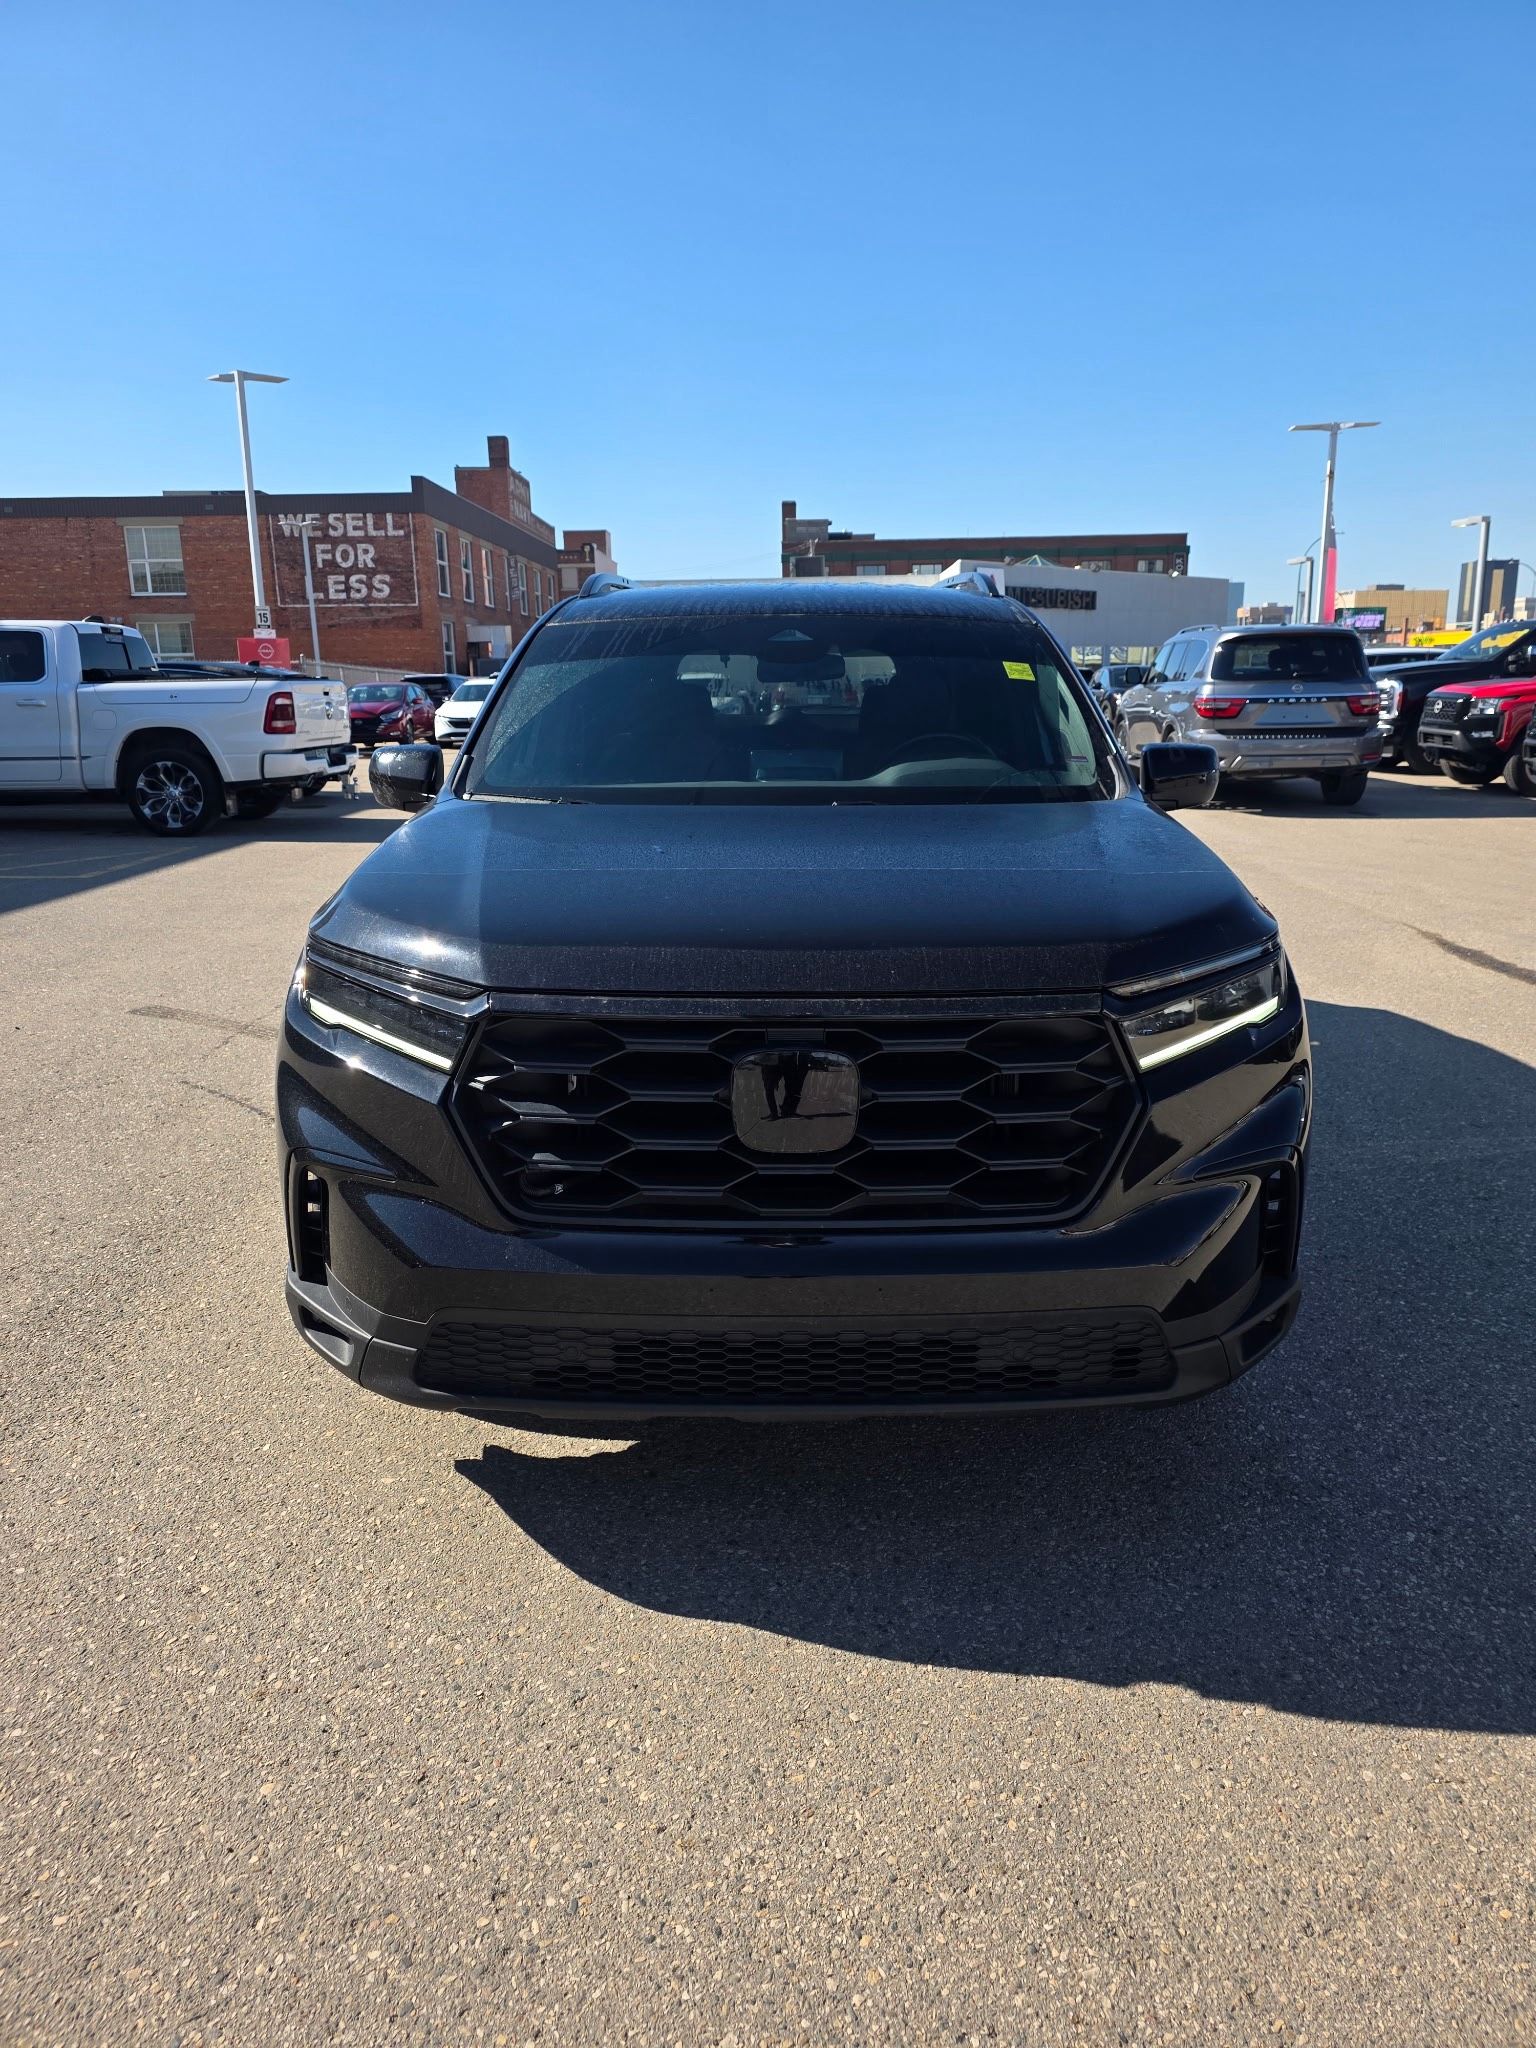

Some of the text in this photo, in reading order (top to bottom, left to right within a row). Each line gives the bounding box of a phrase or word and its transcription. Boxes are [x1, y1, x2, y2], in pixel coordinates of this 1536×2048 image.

[278, 512, 404, 537] WE SELL
[315, 543, 376, 568] FOR
[258, 612, 269, 624] 15
